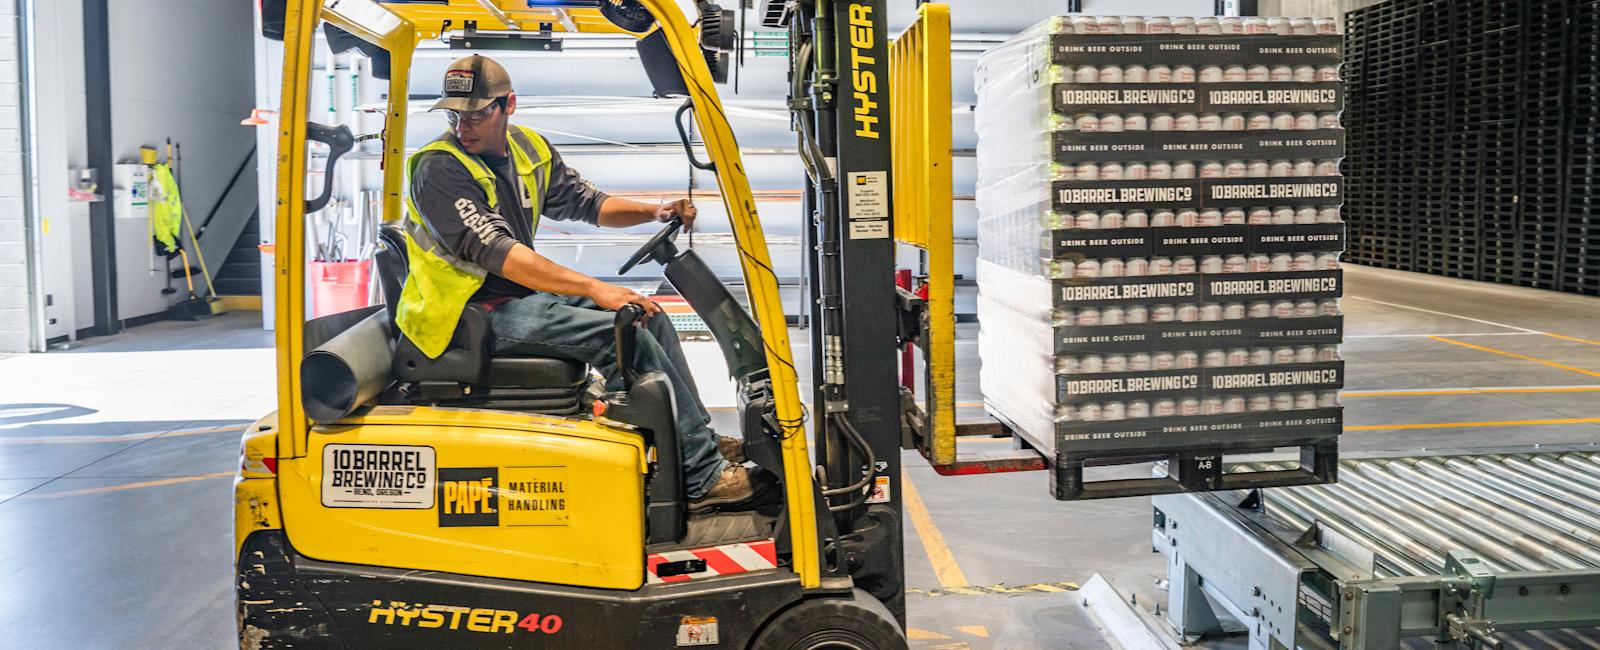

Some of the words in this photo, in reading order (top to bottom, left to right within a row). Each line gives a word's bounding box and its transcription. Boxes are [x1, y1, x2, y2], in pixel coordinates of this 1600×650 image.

[849, 3, 880, 139] HYSTER
[1090, 238, 1108, 246] BEER
[1110, 237, 1144, 246] OUTSIDE
[1210, 329, 1242, 337] OUTSIDE
[1304, 417, 1336, 425] OUTSIDE
[1210, 422, 1242, 431] OUTSIDE
[1114, 430, 1146, 439] OUTSIDE
[1198, 461, 1212, 470] A-B
[509, 482, 564, 493] MATERIAL
[508, 499, 565, 511] HANDLING
[368, 600, 518, 634] HYSTER
[518, 613, 563, 634] 40
